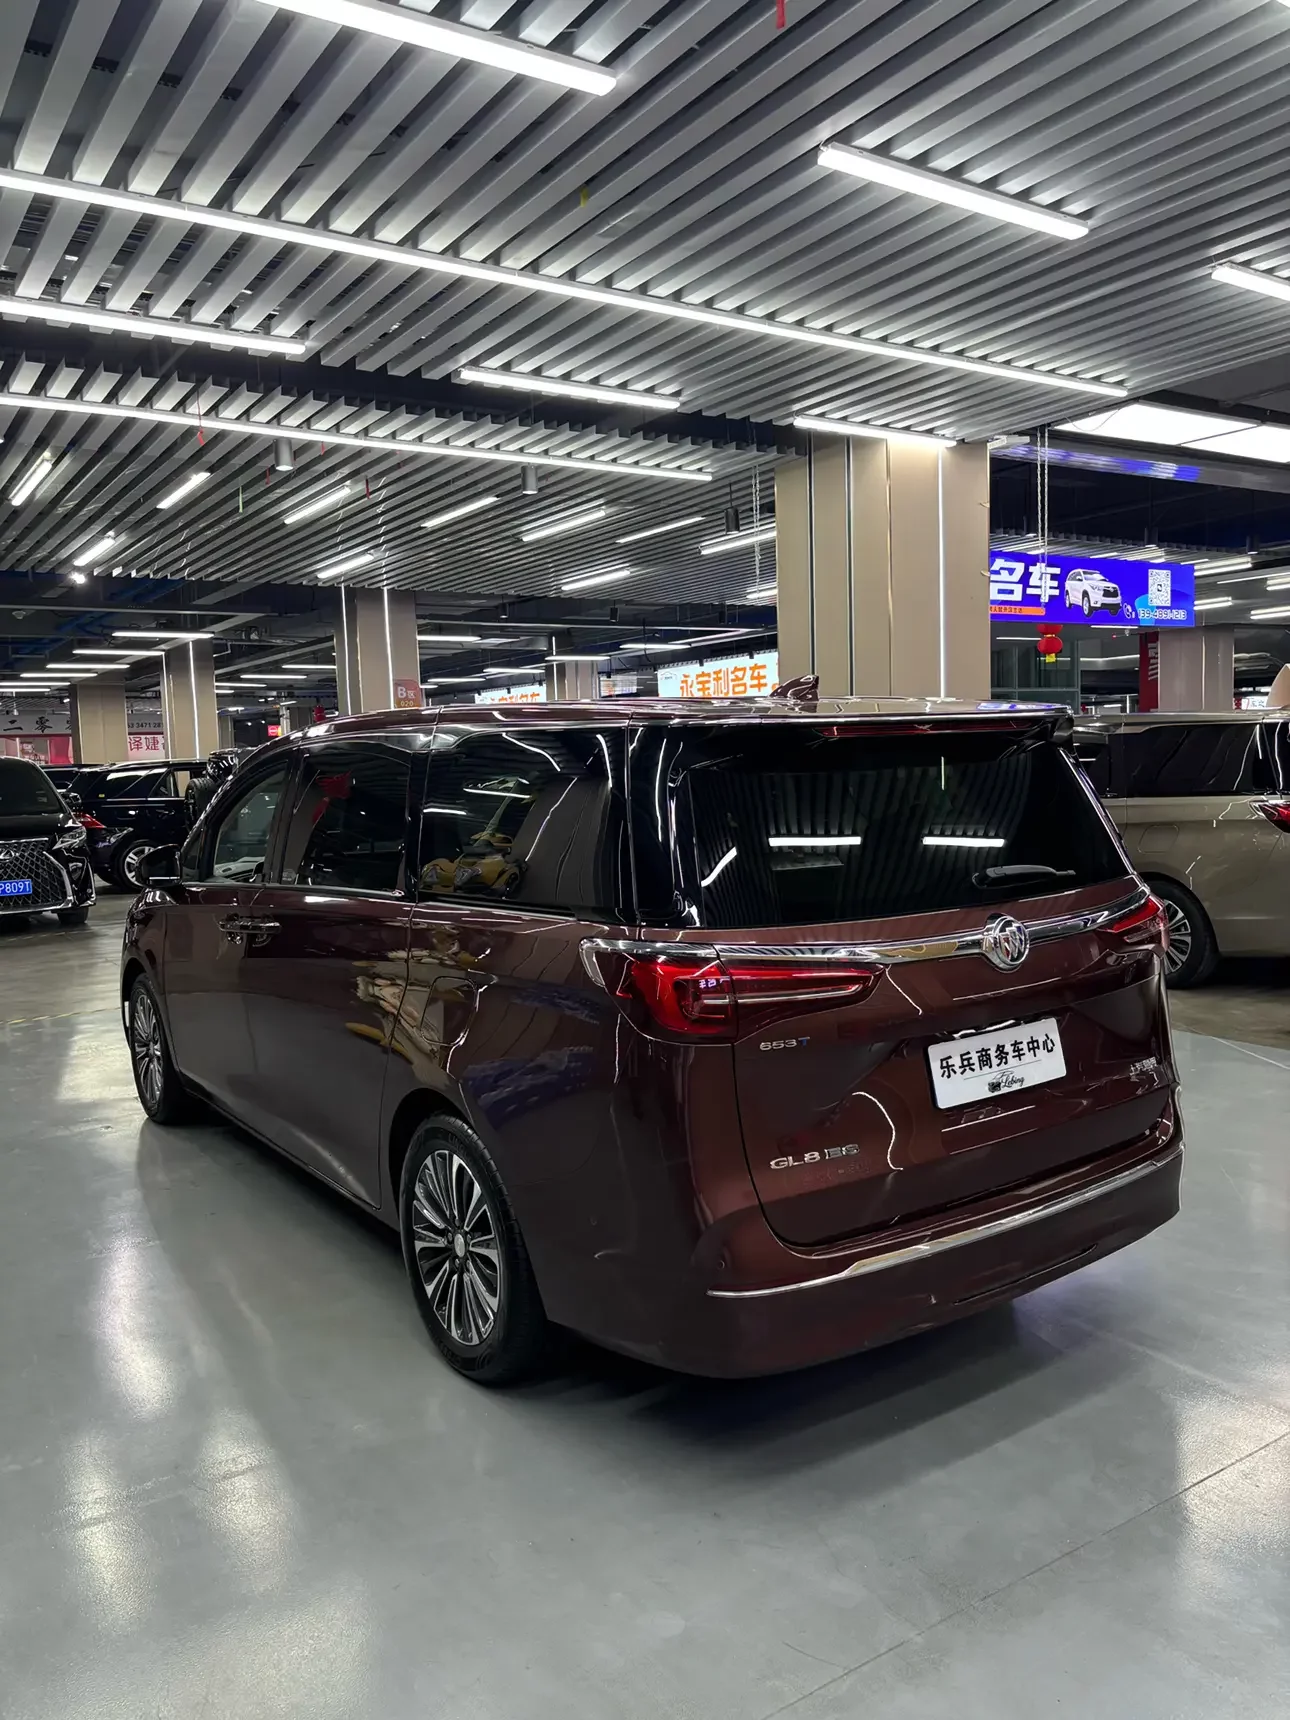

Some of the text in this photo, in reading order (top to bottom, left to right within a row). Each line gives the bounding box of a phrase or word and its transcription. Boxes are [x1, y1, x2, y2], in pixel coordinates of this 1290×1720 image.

[990, 558, 1061, 603] 名车
[680, 663, 768, 697] 永宝利名车
[128, 736, 165, 751] 译婕
[760, 1036, 811, 1051] 653T
[940, 1033, 1056, 1080] 乐兵商务车中心
[769, 1151, 821, 1169] GL8
